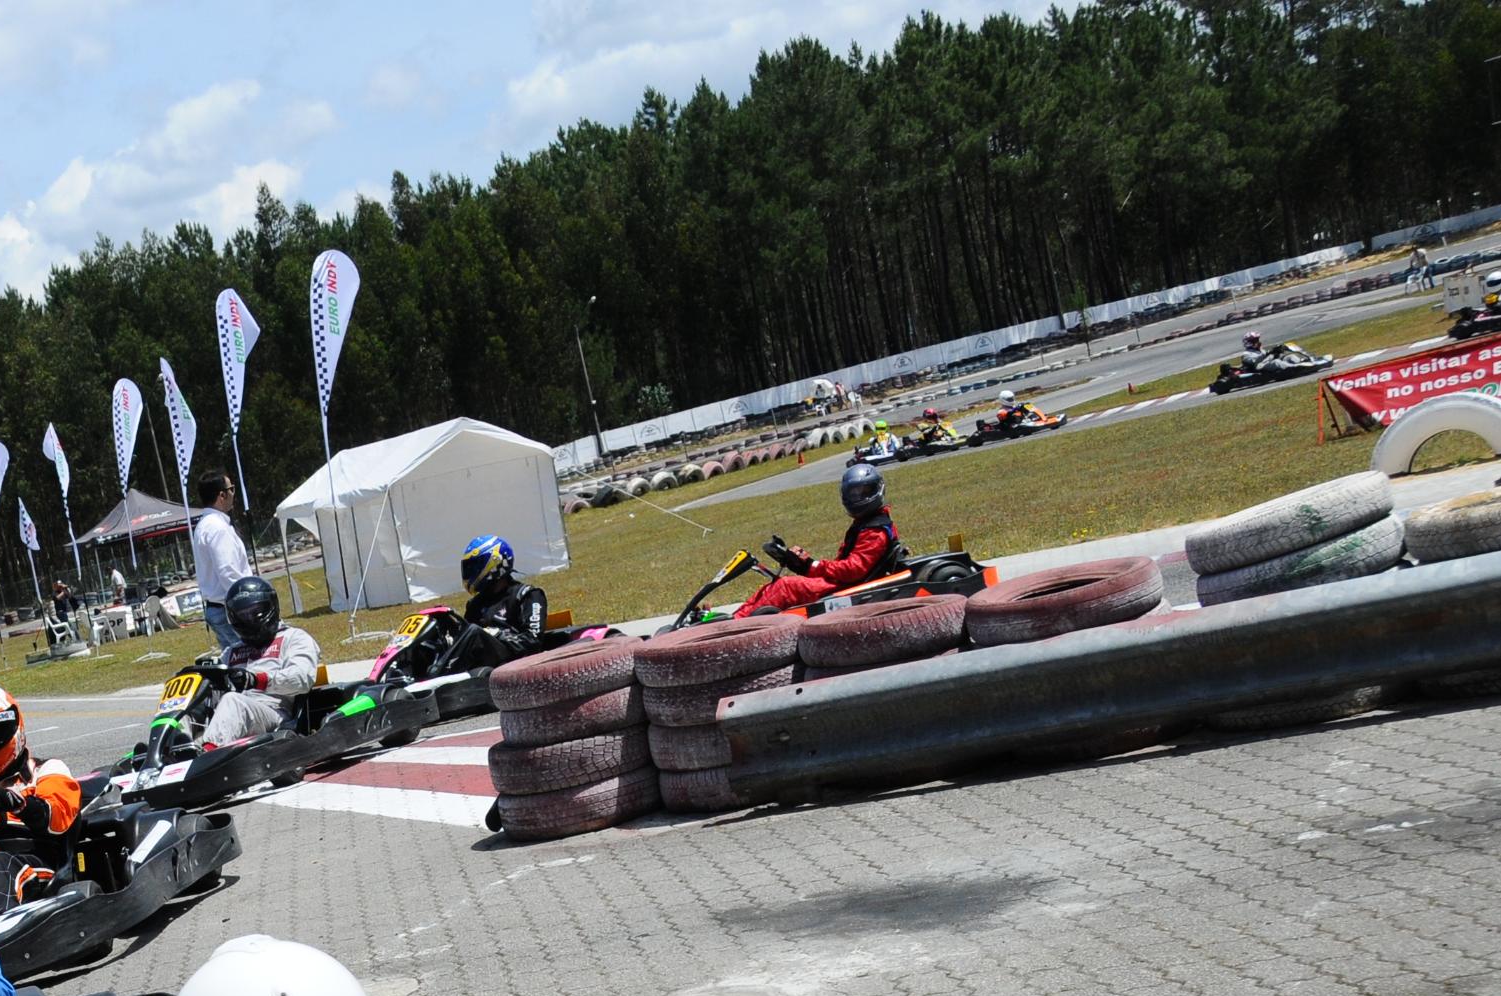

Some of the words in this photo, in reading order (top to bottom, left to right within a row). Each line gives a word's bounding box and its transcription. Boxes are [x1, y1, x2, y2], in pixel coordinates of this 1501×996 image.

[326, 260, 339, 295] INDY
[228, 298, 241, 329] INDY
[328, 296, 341, 336] EURO
[233, 330, 245, 364] EURO
[1327, 371, 1392, 392] Venha
[1399, 353, 1471, 378] visitar
[1386, 384, 1414, 399] no
[1420, 368, 1486, 393] nosso
[162, 676, 195, 701] 100
